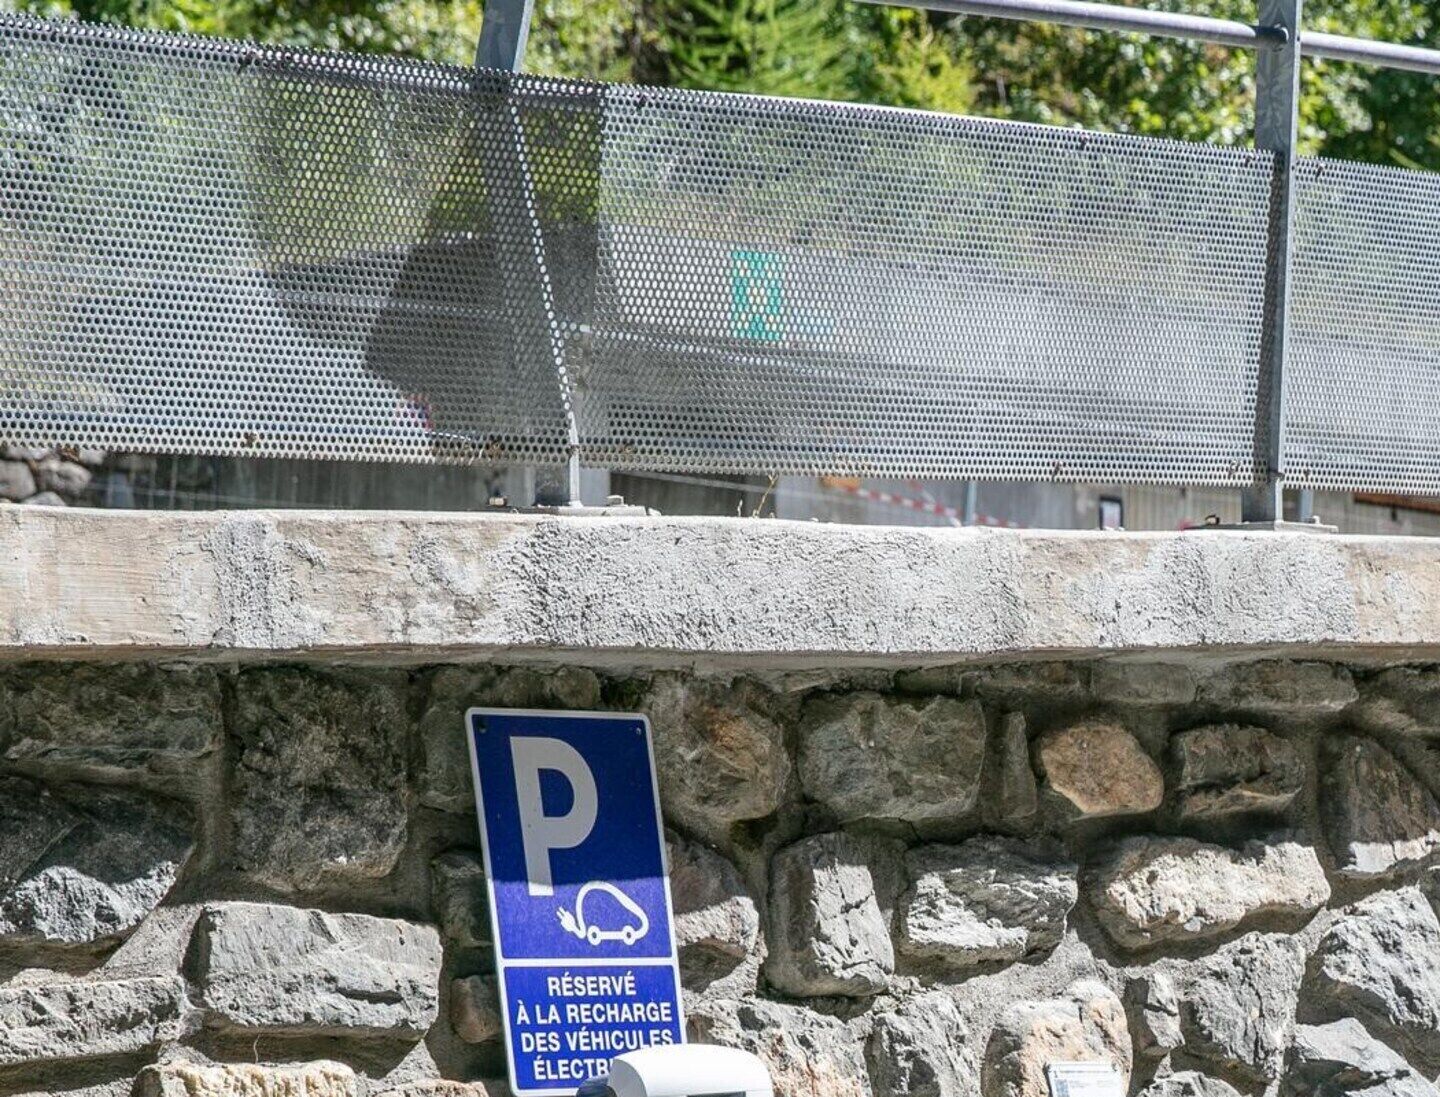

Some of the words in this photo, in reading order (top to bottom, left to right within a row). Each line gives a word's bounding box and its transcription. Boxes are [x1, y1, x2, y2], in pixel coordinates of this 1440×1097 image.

[510, 736, 598, 896] P
[547, 971, 636, 997] RÉSERVÉ
[517, 1000, 532, 1025] À
[536, 1002, 559, 1024] LA
[566, 1000, 672, 1023] RECHARGE
[522, 1032, 560, 1053] DES
[569, 1026, 673, 1051] VÉHICULES
